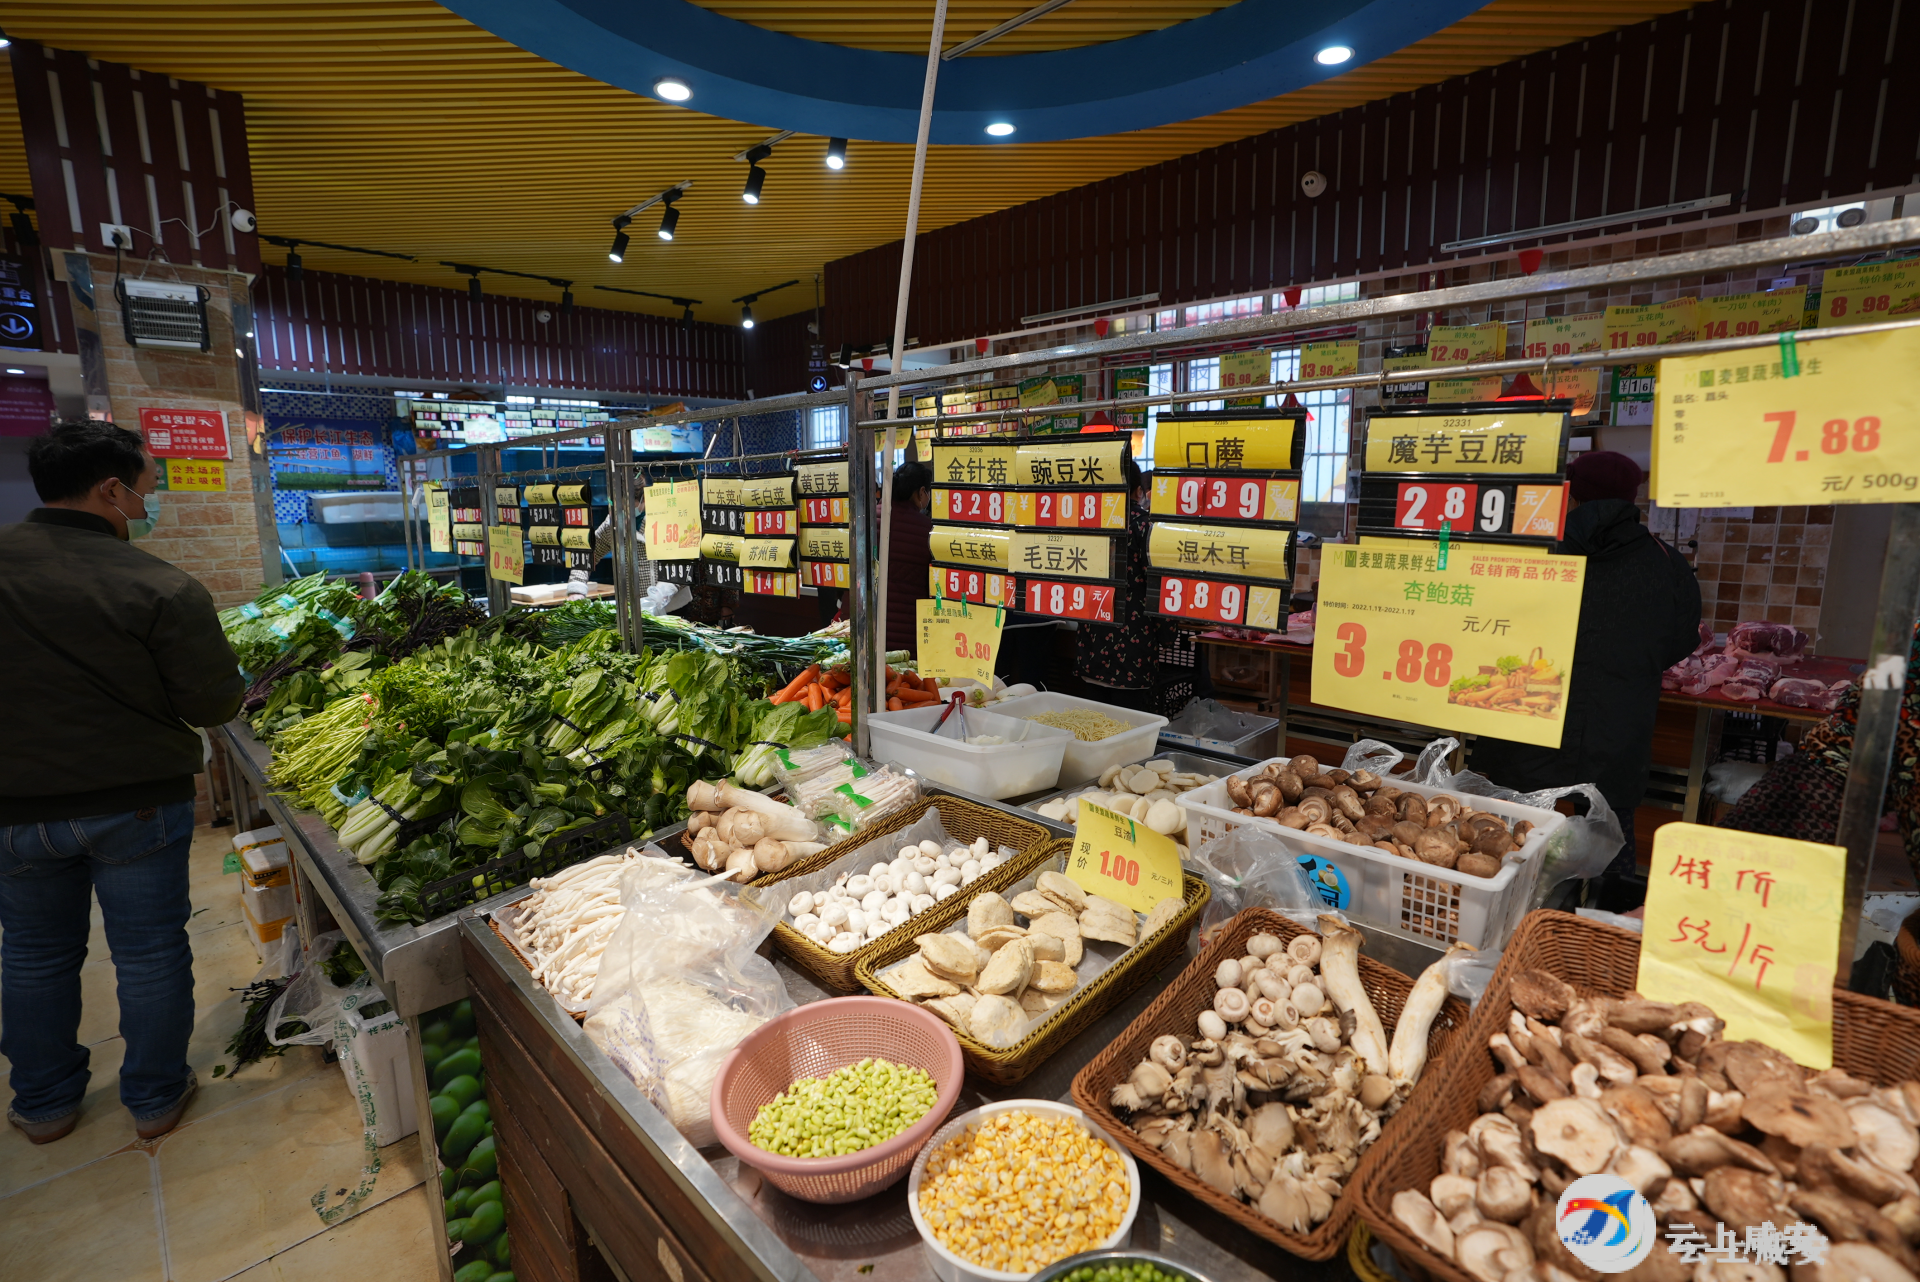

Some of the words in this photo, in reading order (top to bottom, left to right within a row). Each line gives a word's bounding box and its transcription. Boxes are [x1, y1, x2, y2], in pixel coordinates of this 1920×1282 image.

[1859, 272, 1905, 284] 特价猪肉
[1894, 281, 1916, 289] 元/斤
[0, 286, 32, 300] 重台
[1762, 308, 1781, 316] 元/斤
[1830, 294, 1891, 318] 8.98
[1636, 312, 1664, 322] 五花肉
[1609, 331, 1658, 349] 11.90
[1704, 320, 1760, 340] 14.90
[1431, 345, 1469, 361] 12.49
[1221, 372, 1251, 387] 16.98
[1301, 363, 1333, 378] 13.98
[160, 414, 216, 427] 温馨提示
[1443, 418, 1471, 428] 32331
[281, 429, 374, 446] 保护长江生态
[1763, 410, 1882, 463] 7.88
[1186, 437, 1245, 473] 口蘑
[1387, 433, 1528, 465] 魔芋豆腐
[172, 465, 220, 474] 公共场所
[947, 457, 1008, 485] 金针菇
[1030, 456, 1105, 485] 豌豆米
[172, 477, 221, 485] 禁止吸烟
[800, 472, 840, 494] 黄豆芽
[751, 486, 786, 506] 毛白菜
[952, 493, 1002, 520] 3.28
[1181, 480, 1260, 518] 9.39
[808, 500, 843, 521] 1.68
[1040, 494, 1096, 520] 20.8
[1401, 486, 1506, 533] 2.89
[712, 509, 736, 531] 2.88
[756, 512, 783, 533] 1.99
[535, 531, 555, 545] 上海青
[566, 535, 586, 546] 小白菜
[652, 521, 679, 545] 1.58
[1203, 530, 1226, 538] 32123
[748, 546, 779, 562] 苏州青
[808, 540, 845, 558] 绿豆芽
[949, 540, 998, 563] 白玉菇
[1023, 545, 1088, 574] 毛豆米
[1176, 540, 1250, 570] 湿木耳
[494, 551, 513, 571] 0.99
[1359, 552, 1437, 573] 麦盟蔬果鲜生
[716, 565, 741, 584] 8.18
[813, 564, 845, 585] 1.68
[1470, 562, 1579, 583] 促销商品价签
[949, 572, 1001, 597] 5.88
[1403, 580, 1476, 607] 杏鲍菇
[1031, 583, 1086, 615] 18.9
[1092, 590, 1111, 621] 元/kg
[1164, 578, 1241, 621] 3.89
[1462, 616, 1511, 637] 元/斤
[955, 632, 991, 662] 3.80
[1334, 622, 1454, 688] 3.88
[1100, 850, 1140, 887] 1.00
